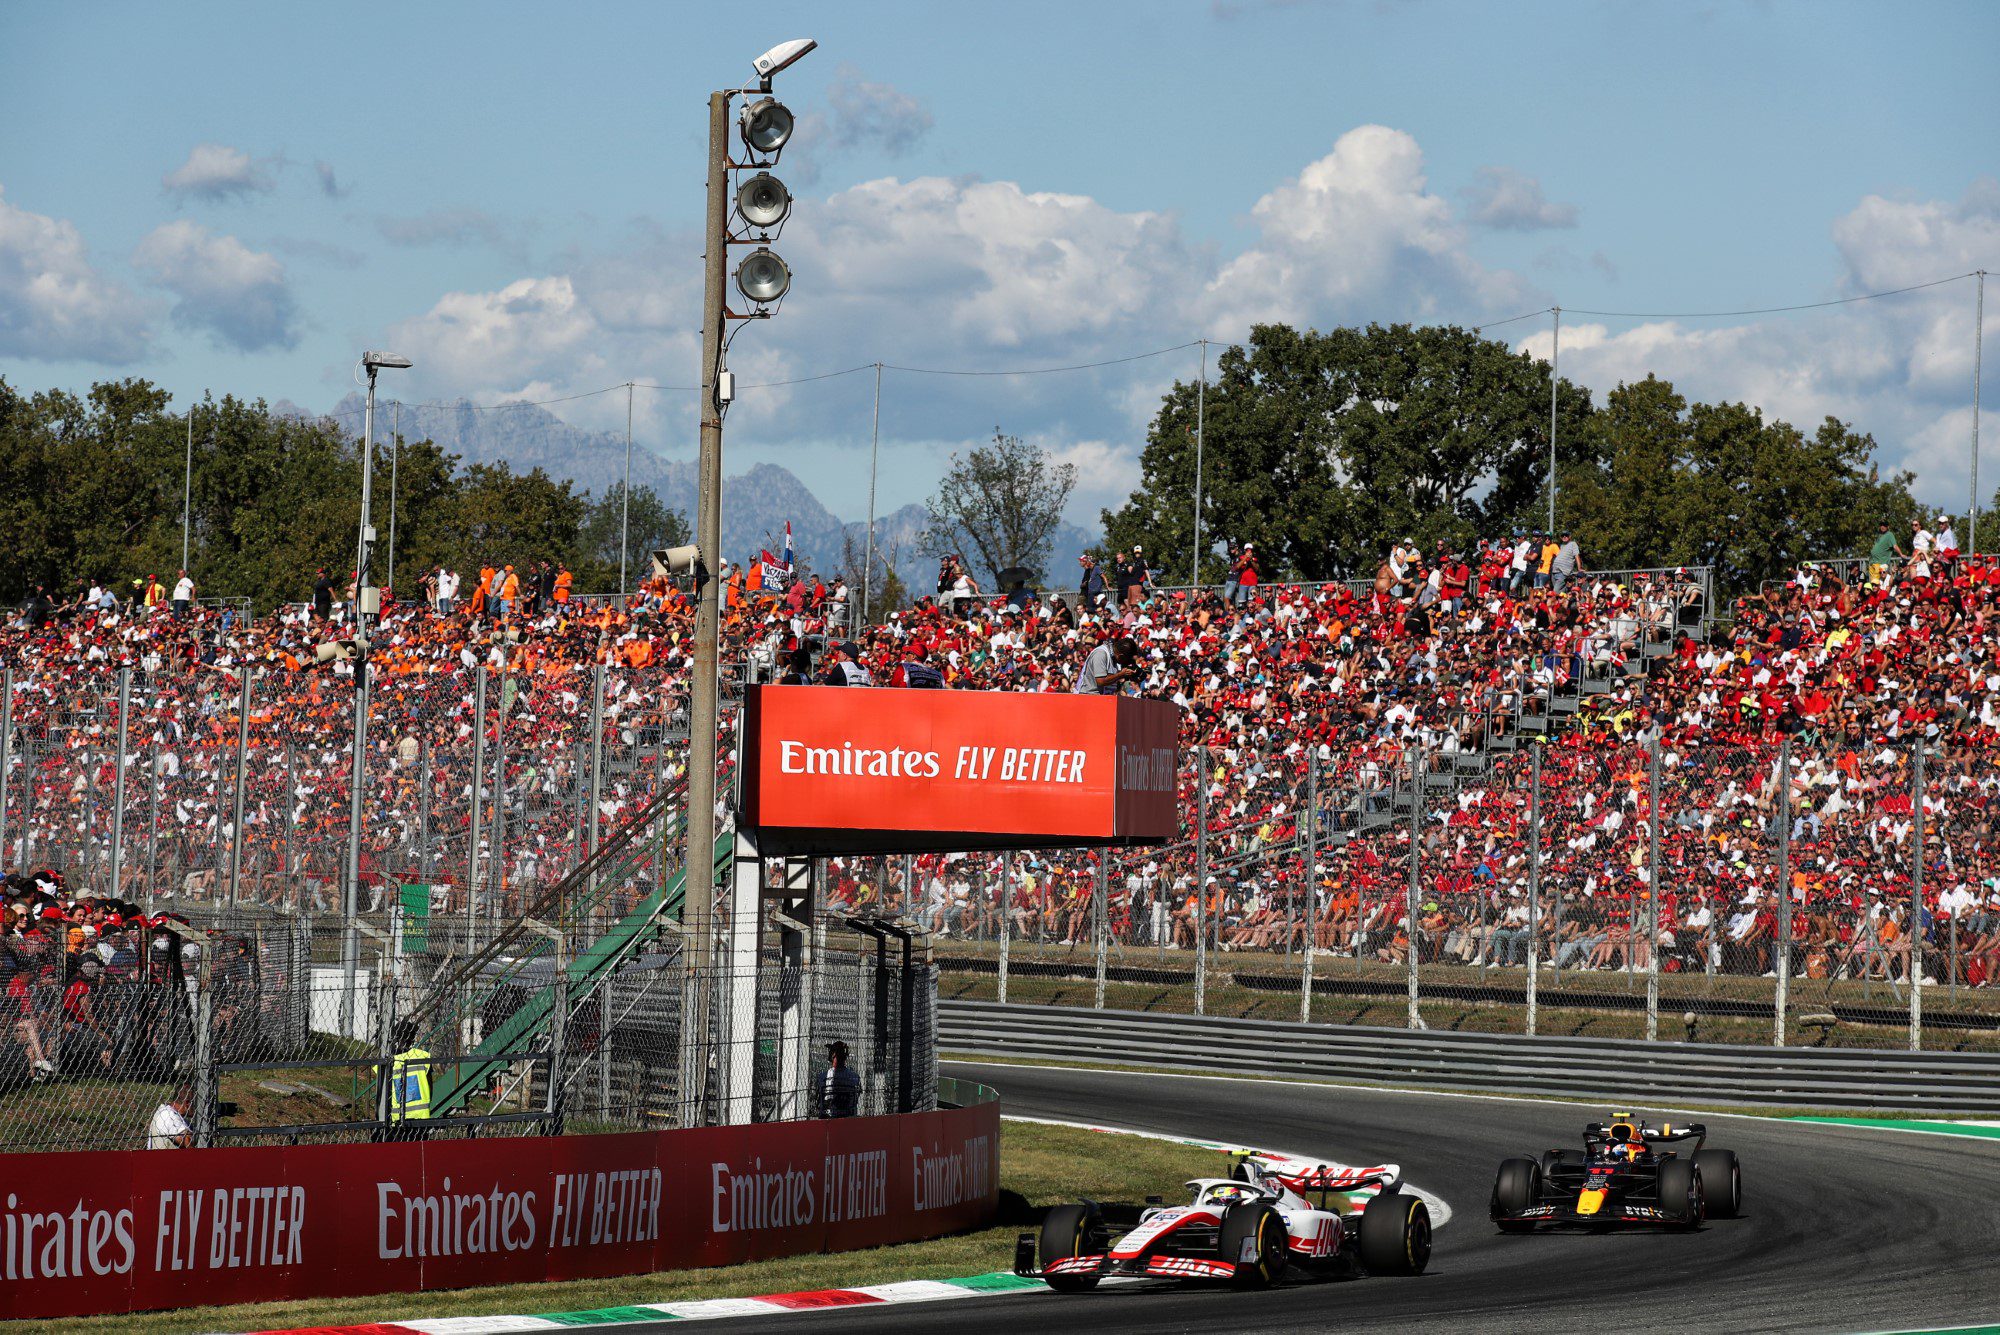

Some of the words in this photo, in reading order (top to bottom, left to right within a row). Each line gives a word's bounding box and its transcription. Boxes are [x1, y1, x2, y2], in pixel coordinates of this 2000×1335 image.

[779, 740, 940, 778] Emirates
[954, 745, 997, 780] FLY
[1000, 746, 1087, 783] BETTER
[1122, 744, 1149, 791] Emirates
[712, 1157, 815, 1233] Emirates
[822, 1154, 845, 1223] FLY
[847, 1149, 887, 1220] BETTER
[913, 1141, 962, 1211] Emirates
[1589, 1167, 1614, 1175] 11
[0, 1193, 136, 1280] irates
[155, 1190, 204, 1272] FLY
[209, 1186, 305, 1269] BETTER
[377, 1177, 536, 1260] Emirates
[549, 1173, 588, 1248] FLY
[590, 1168, 662, 1245] BETTER
